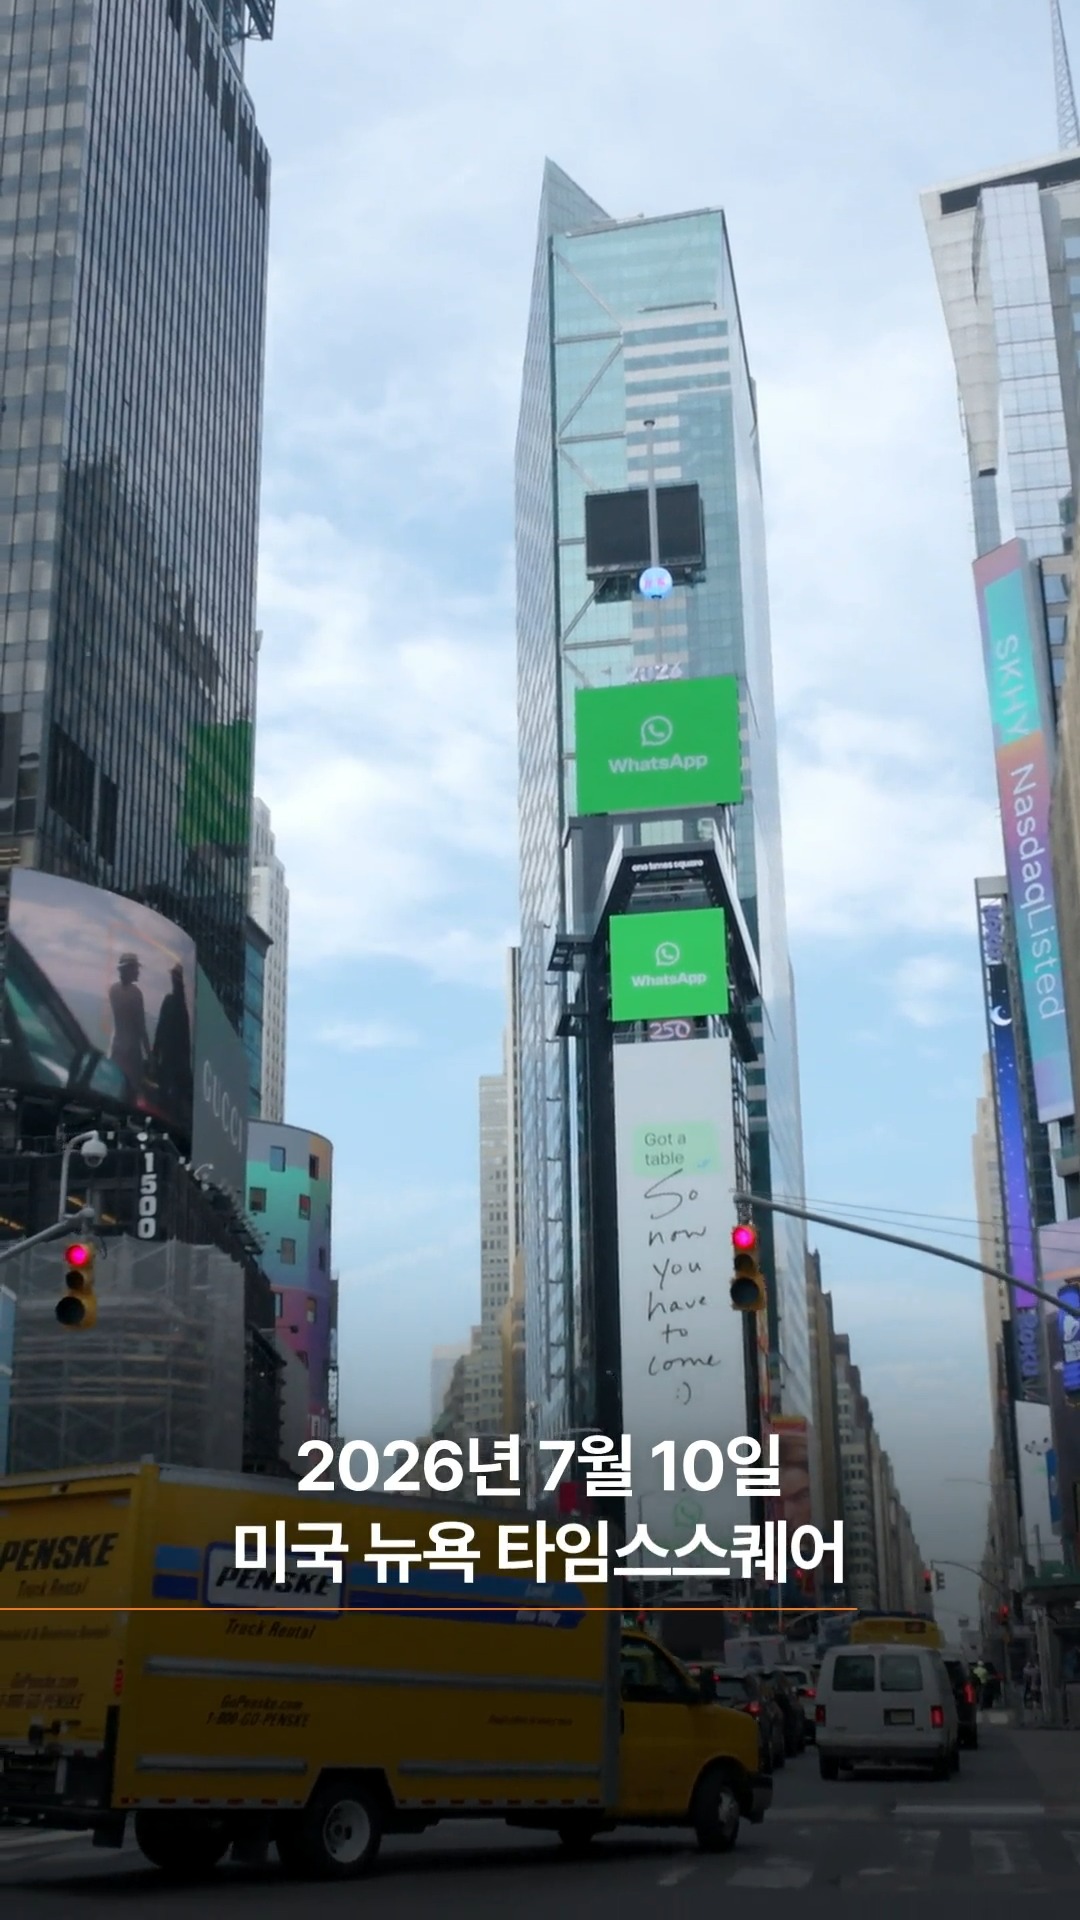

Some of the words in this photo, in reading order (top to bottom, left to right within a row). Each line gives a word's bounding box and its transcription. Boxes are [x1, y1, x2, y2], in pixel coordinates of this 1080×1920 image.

[996, 634, 1031, 736] SKHY
[607, 753, 708, 774] WhatsApp
[631, 863, 648, 873] one
[648, 861, 673, 871] times
[673, 859, 704, 870] square
[631, 972, 707, 987] WhatsApp
[649, 1019, 691, 1040] 250
[203, 1059, 242, 1153] GUCCI
[644, 1132, 672, 1147] Got
[677, 1133, 686, 1145] a
[645, 1152, 685, 1166] table
[137, 1152, 157, 1239] 1500
[643, 1167, 698, 1220] So
[648, 1226, 707, 1247] now
[652, 1258, 701, 1291] you
[647, 1291, 707, 1321] have
[661, 1323, 689, 1344] to
[647, 1354, 721, 1376] come
[0, 1532, 119, 1573] PENSKE
[215, 1566, 332, 1597] PENSKE
[225, 1618, 266, 1638] Truck
[268, 1621, 317, 1640] Rental
[220, 1694, 304, 1712] GoPenske.com
